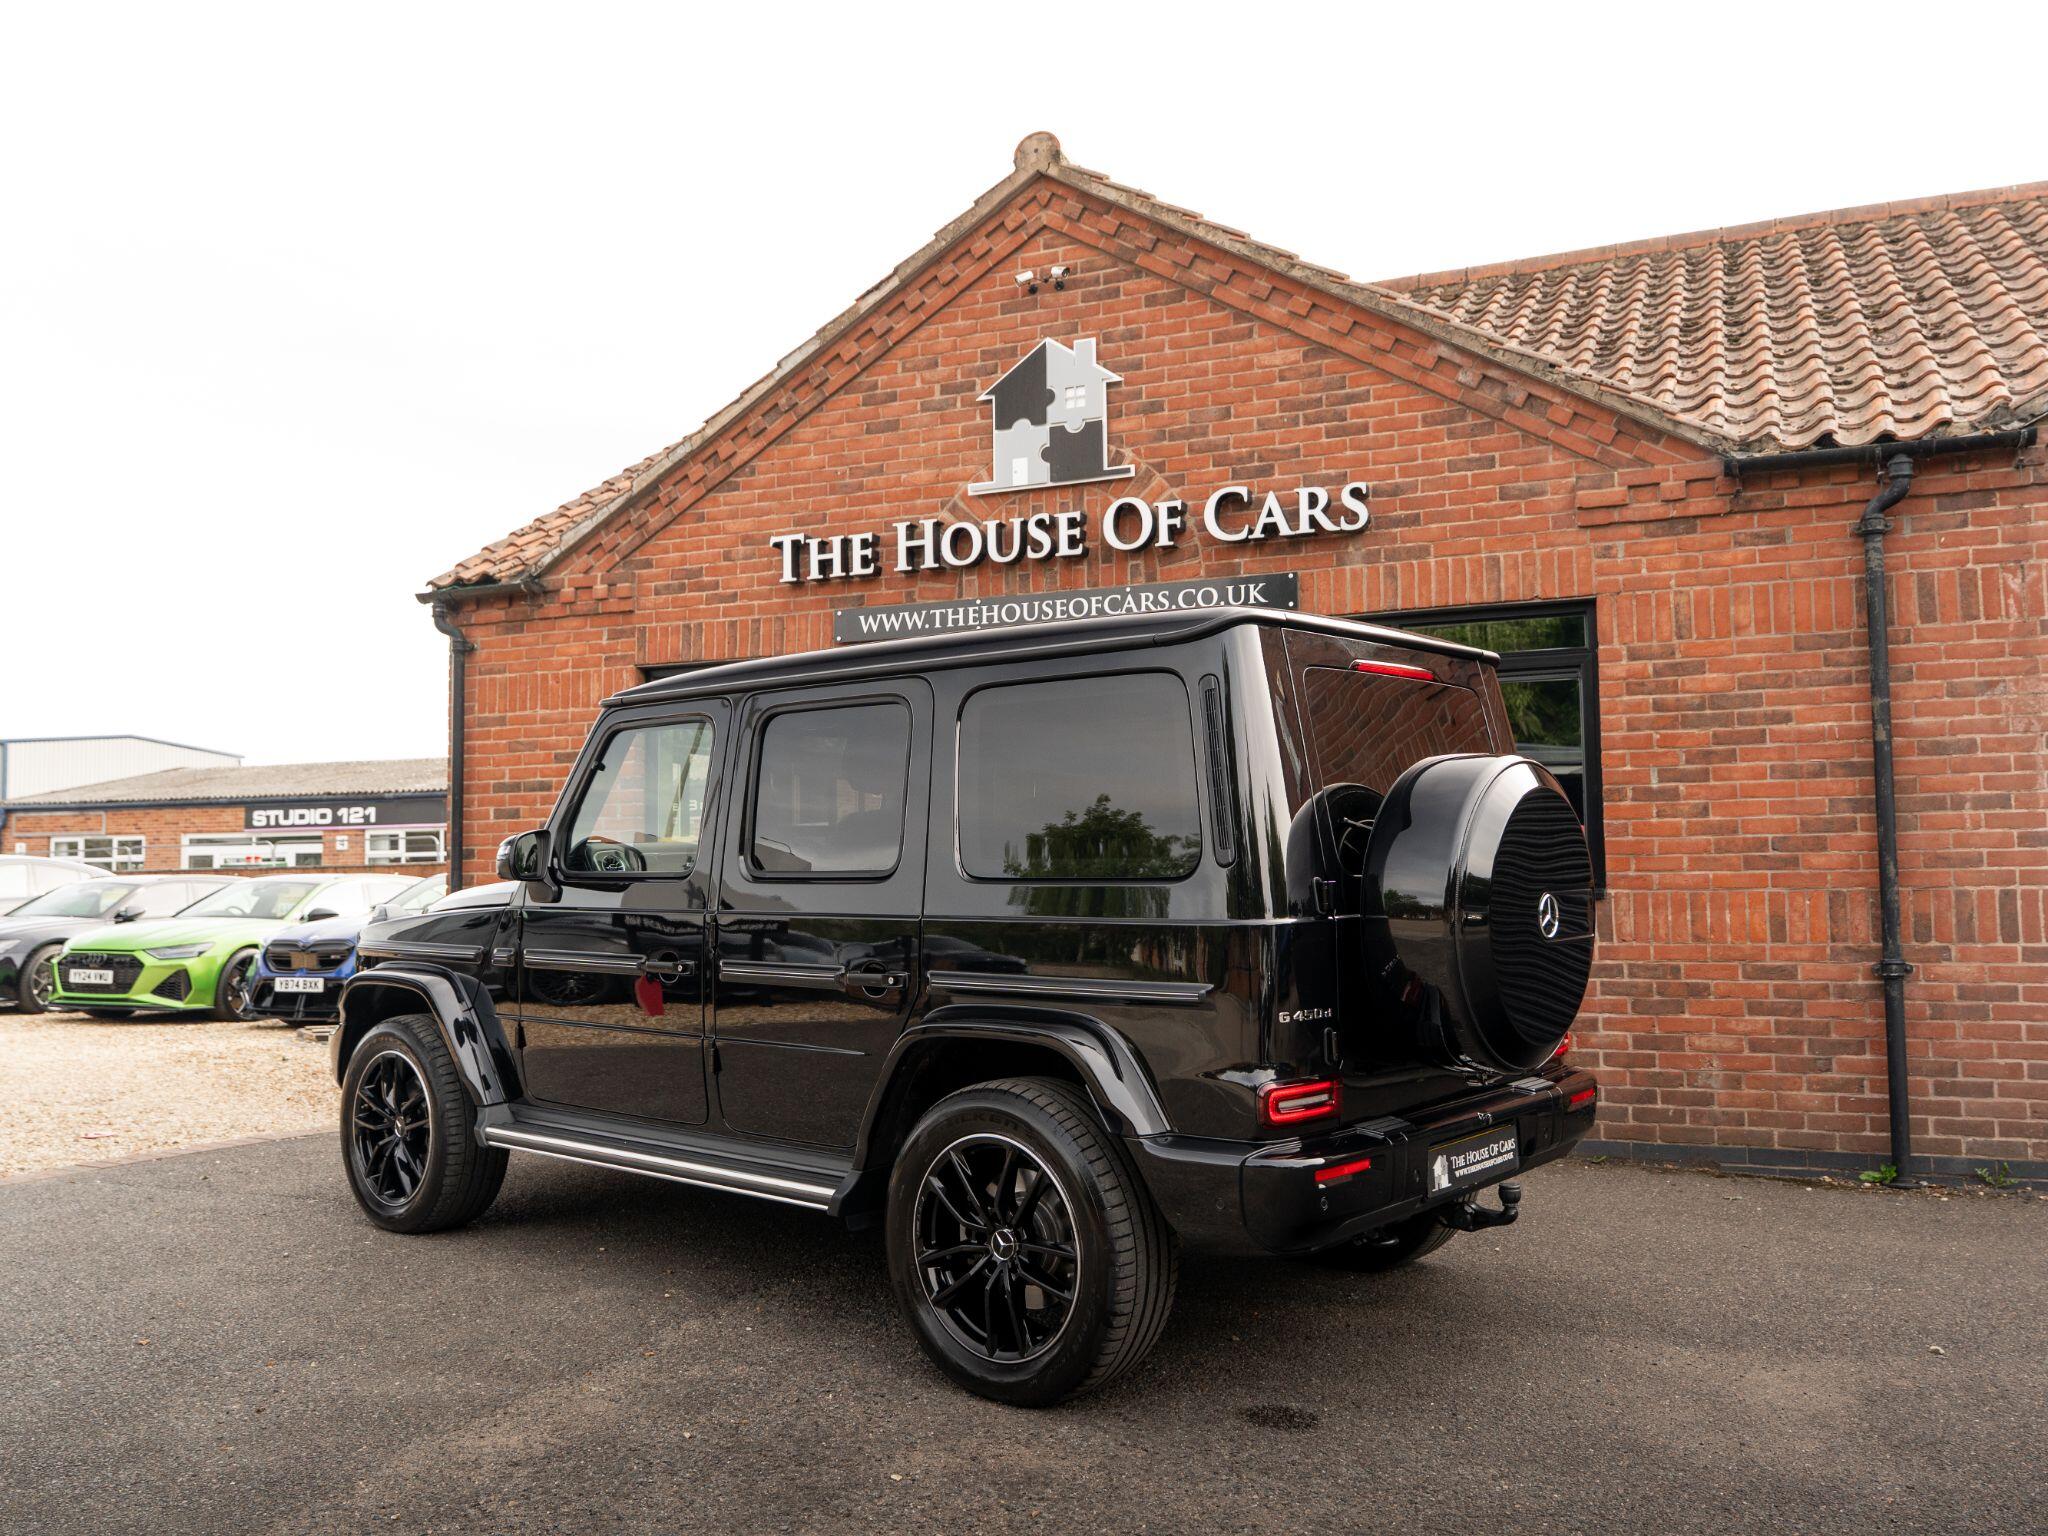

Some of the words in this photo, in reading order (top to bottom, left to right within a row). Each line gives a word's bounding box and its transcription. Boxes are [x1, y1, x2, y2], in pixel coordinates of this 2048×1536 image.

[769, 532, 877, 583] THE
[892, 510, 1085, 573] HOUSE
[1102, 496, 1184, 550] OF
[1203, 481, 1370, 542] CARS
[858, 581, 1269, 635] WWW.THEHOUSEOFCARS.CO.UK
[252, 808, 332, 827] STUDIO
[336, 801, 377, 824] 121
[1450, 1155, 1465, 1168] THE
[1466, 1147, 1489, 1164] HOUSE
[1490, 1143, 1499, 1156] OF
[1499, 1138, 1515, 1152] CARS
